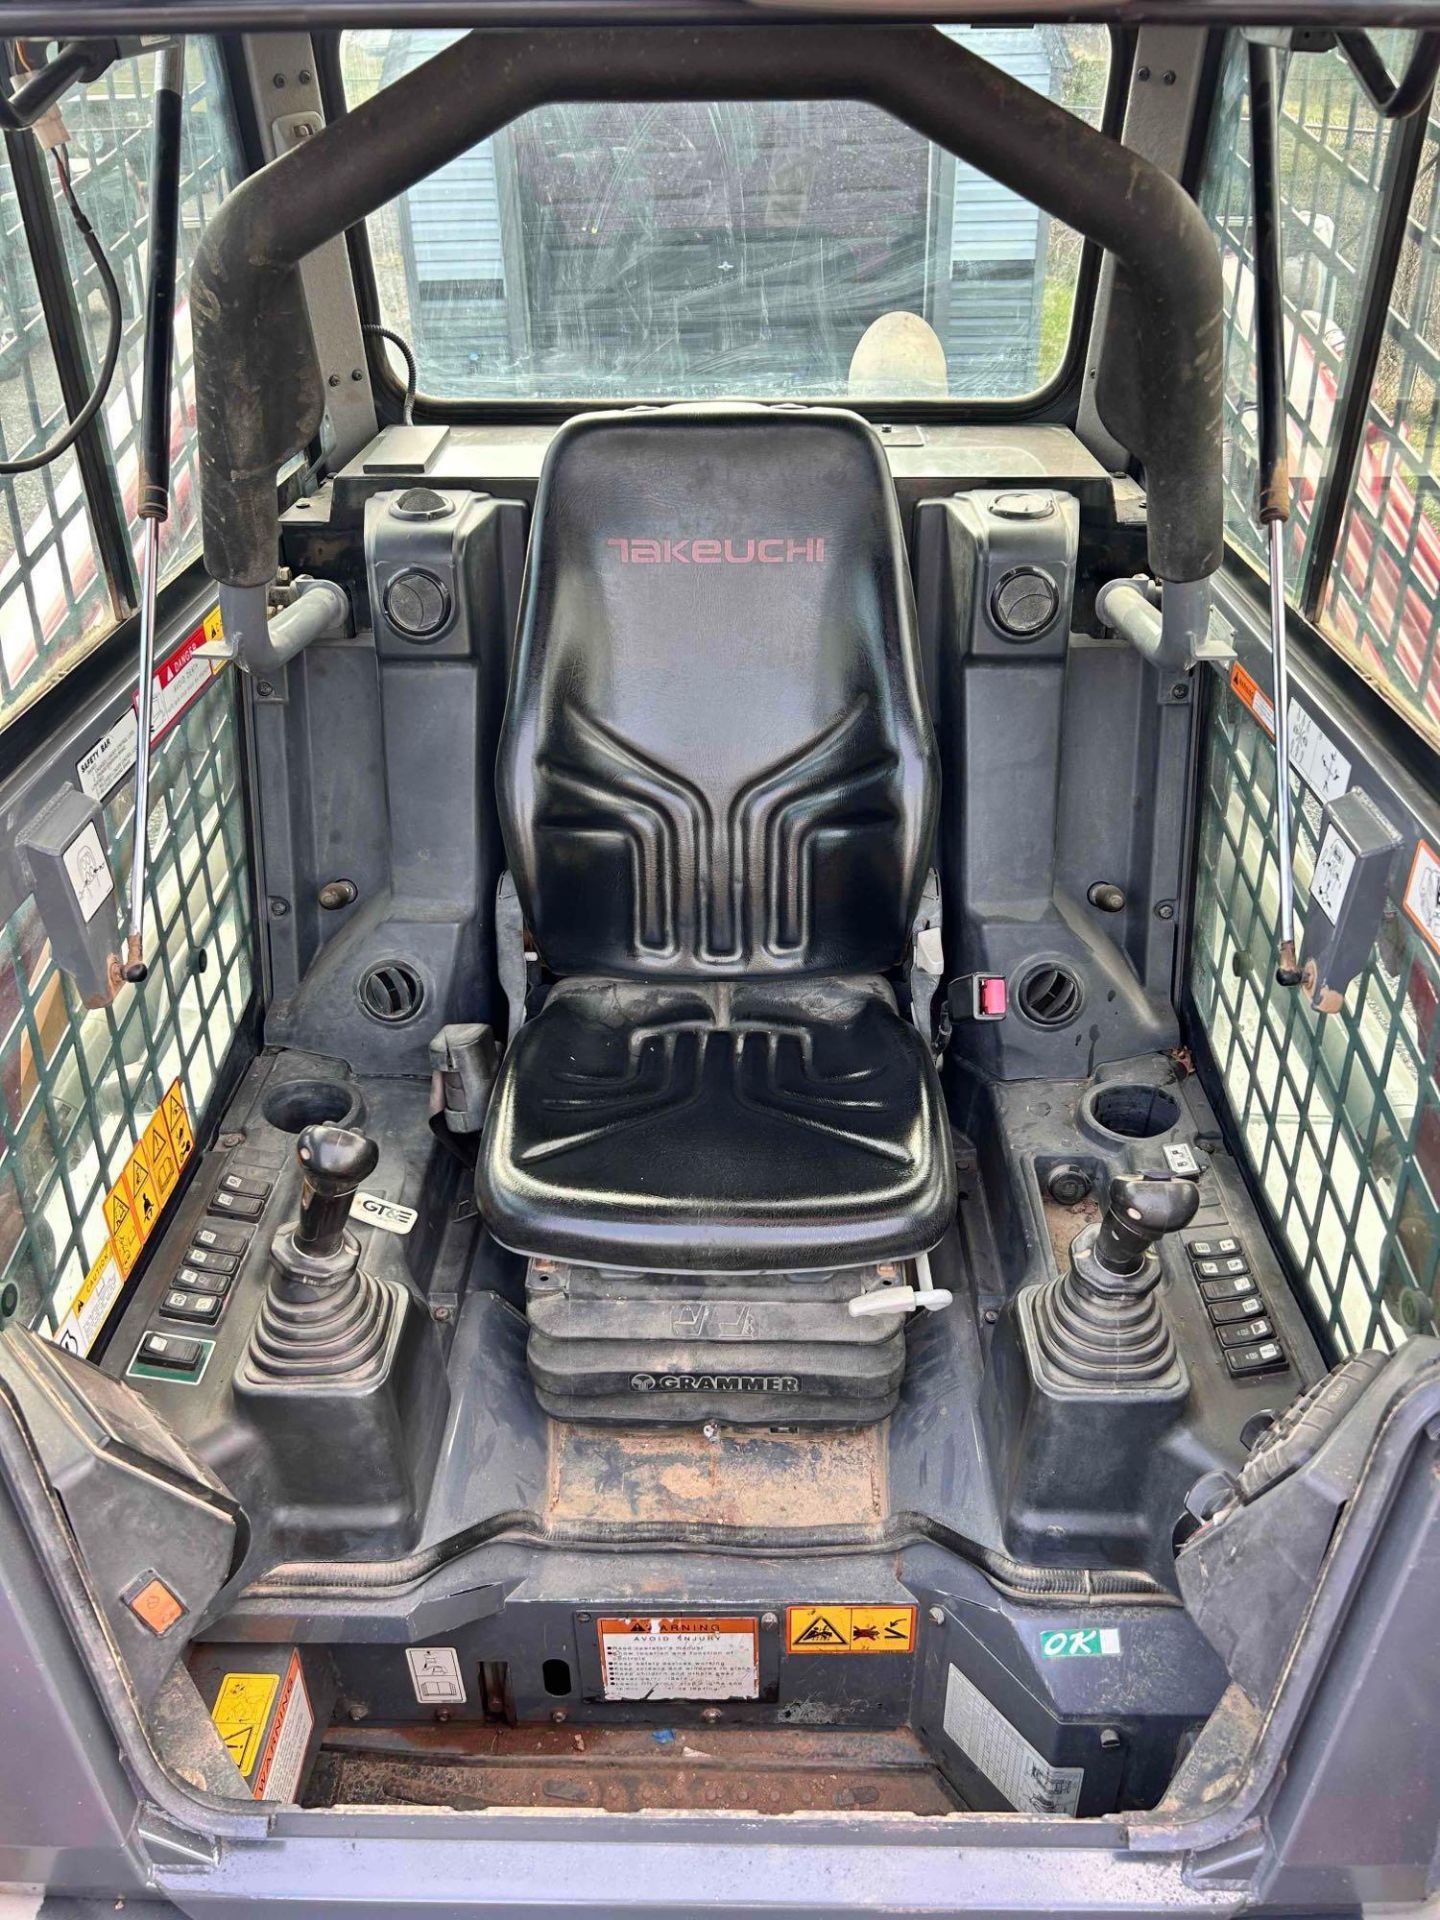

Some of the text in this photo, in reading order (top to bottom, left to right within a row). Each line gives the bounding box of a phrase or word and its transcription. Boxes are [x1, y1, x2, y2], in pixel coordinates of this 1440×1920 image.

[80, 749, 99, 773] SAFETY
[86, 1255, 109, 1293] CAUTION
[659, 1375, 799, 1391] GRAMMER
[648, 1624, 720, 1632] ARNING
[1044, 1630, 1097, 1656] OK
[258, 1677, 294, 1792] WARNING
